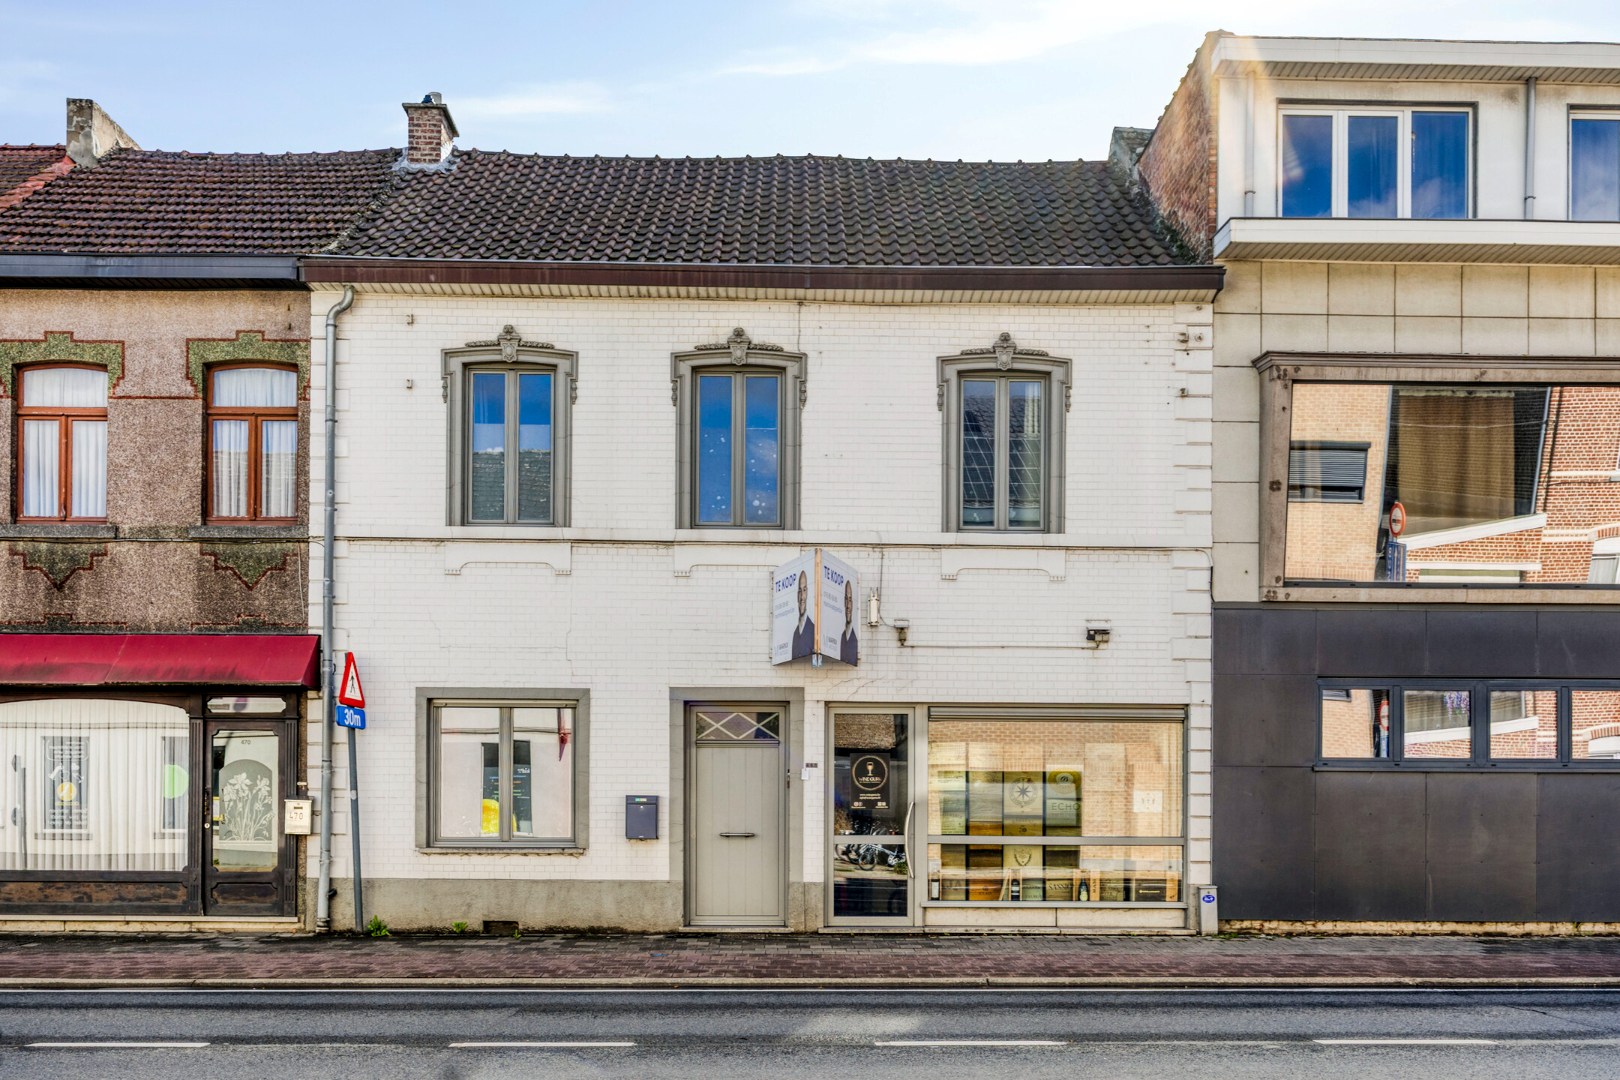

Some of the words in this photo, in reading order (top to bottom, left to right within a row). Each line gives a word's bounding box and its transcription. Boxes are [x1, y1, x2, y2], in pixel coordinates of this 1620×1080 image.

[775, 580, 781, 593] TE
[781, 573, 797, 590] KOOP
[824, 565, 830, 580] TE
[830, 570, 844, 586] KOOP
[344, 709, 361, 727] 30m
[289, 811, 304, 820] 470
[1051, 802, 1081, 811] ECHO
